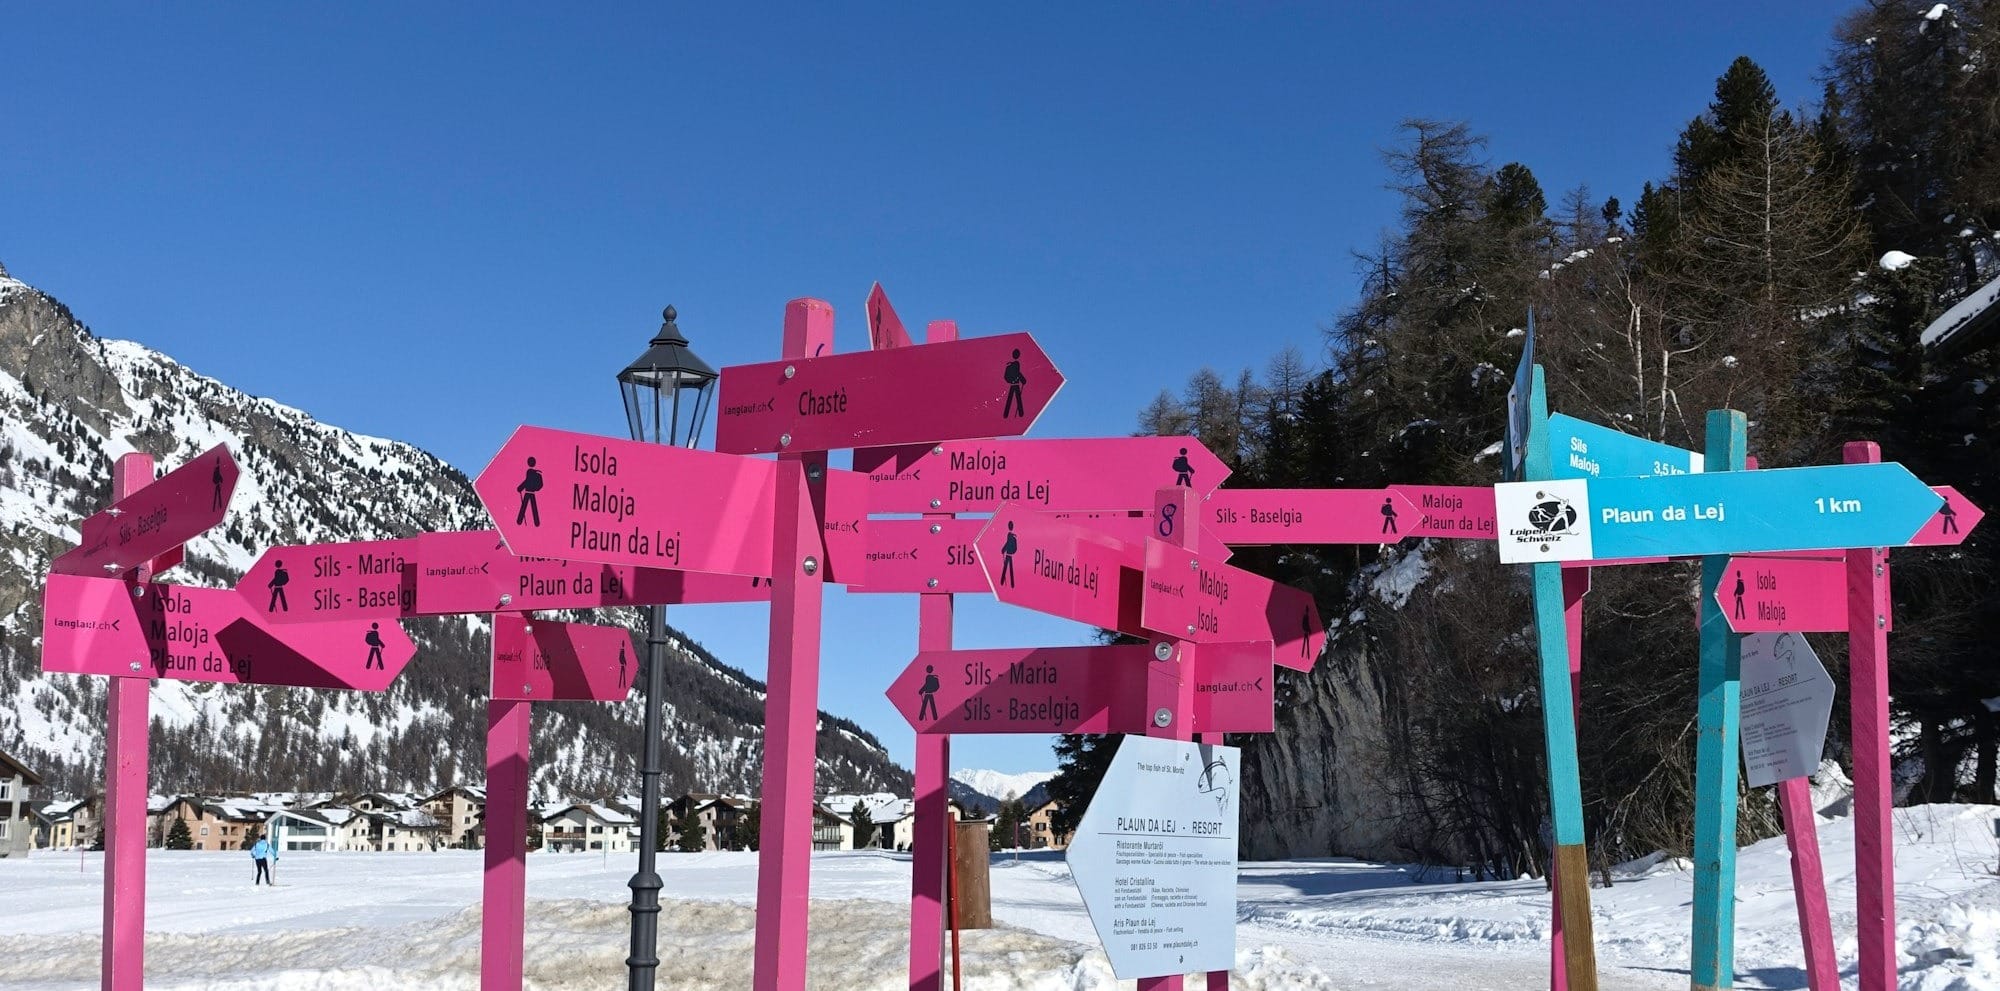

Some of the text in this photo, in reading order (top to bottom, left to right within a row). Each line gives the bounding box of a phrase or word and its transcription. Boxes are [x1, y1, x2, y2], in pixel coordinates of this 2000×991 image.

[724, 401, 767, 416] langlauf.ch
[799, 387, 847, 417] Chastè
[1570, 436, 1588, 453] Sils
[575, 445, 617, 477] Isola
[950, 450, 1006, 477] Maloja
[1569, 453, 1600, 475] Maloja
[1653, 460, 1669, 476] 3,5
[572, 482, 635, 520] Maloja
[949, 480, 1050, 505] Plaun da Lej
[1422, 494, 1463, 511] Maloja
[1602, 503, 1724, 524] Plaun da Lej
[1814, 497, 1862, 514] 1 km
[1159, 503, 1177, 537] 8
[1216, 508, 1237, 524] Sils
[1250, 508, 1302, 527] Baselgia
[1422, 515, 1494, 534] Plaun da Lej
[1510, 527, 1546, 538] Loipen
[1516, 535, 1562, 544] Schweiz
[571, 522, 681, 565] Plaun da Lej
[314, 555, 341, 578] Sils
[359, 552, 405, 575] Maria
[866, 551, 909, 561] nglauf.ch
[947, 545, 975, 566] Sils
[426, 565, 480, 577] langlauf.ch
[1034, 549, 1099, 598] Plaun da Lej
[1757, 571, 1776, 591] Isola
[520, 570, 624, 599] Plaun da Lej
[1150, 580, 1179, 597] langlauf.ch
[1200, 569, 1229, 604] Maloja
[152, 592, 192, 614] Isola
[314, 589, 341, 611] Sils
[359, 584, 417, 611] Baselgi
[1198, 606, 1218, 634] Isola
[1758, 600, 1786, 625] Maloja
[54, 618, 111, 631] langlauf.ch
[151, 621, 208, 648] Maloja
[150, 650, 251, 680] Plaun da Lej
[965, 662, 991, 686] Sils
[1010, 661, 1057, 685] Maria
[1196, 680, 1253, 694] langlauf.ch
[964, 698, 991, 721] Sils
[1009, 696, 1079, 727] Baselgia
[1117, 817, 1145, 832] PLAUN
[1148, 819, 1159, 832] DA
[1161, 820, 1176, 833] LEJ
[1192, 821, 1222, 835] RESORT
[1117, 841, 1142, 850] Ristorante
[1115, 877, 1155, 886] Hotel Cristallina
[1126, 918, 1139, 927] Plaun
[1141, 918, 1147, 926] da
[1148, 917, 1156, 927] Lej
